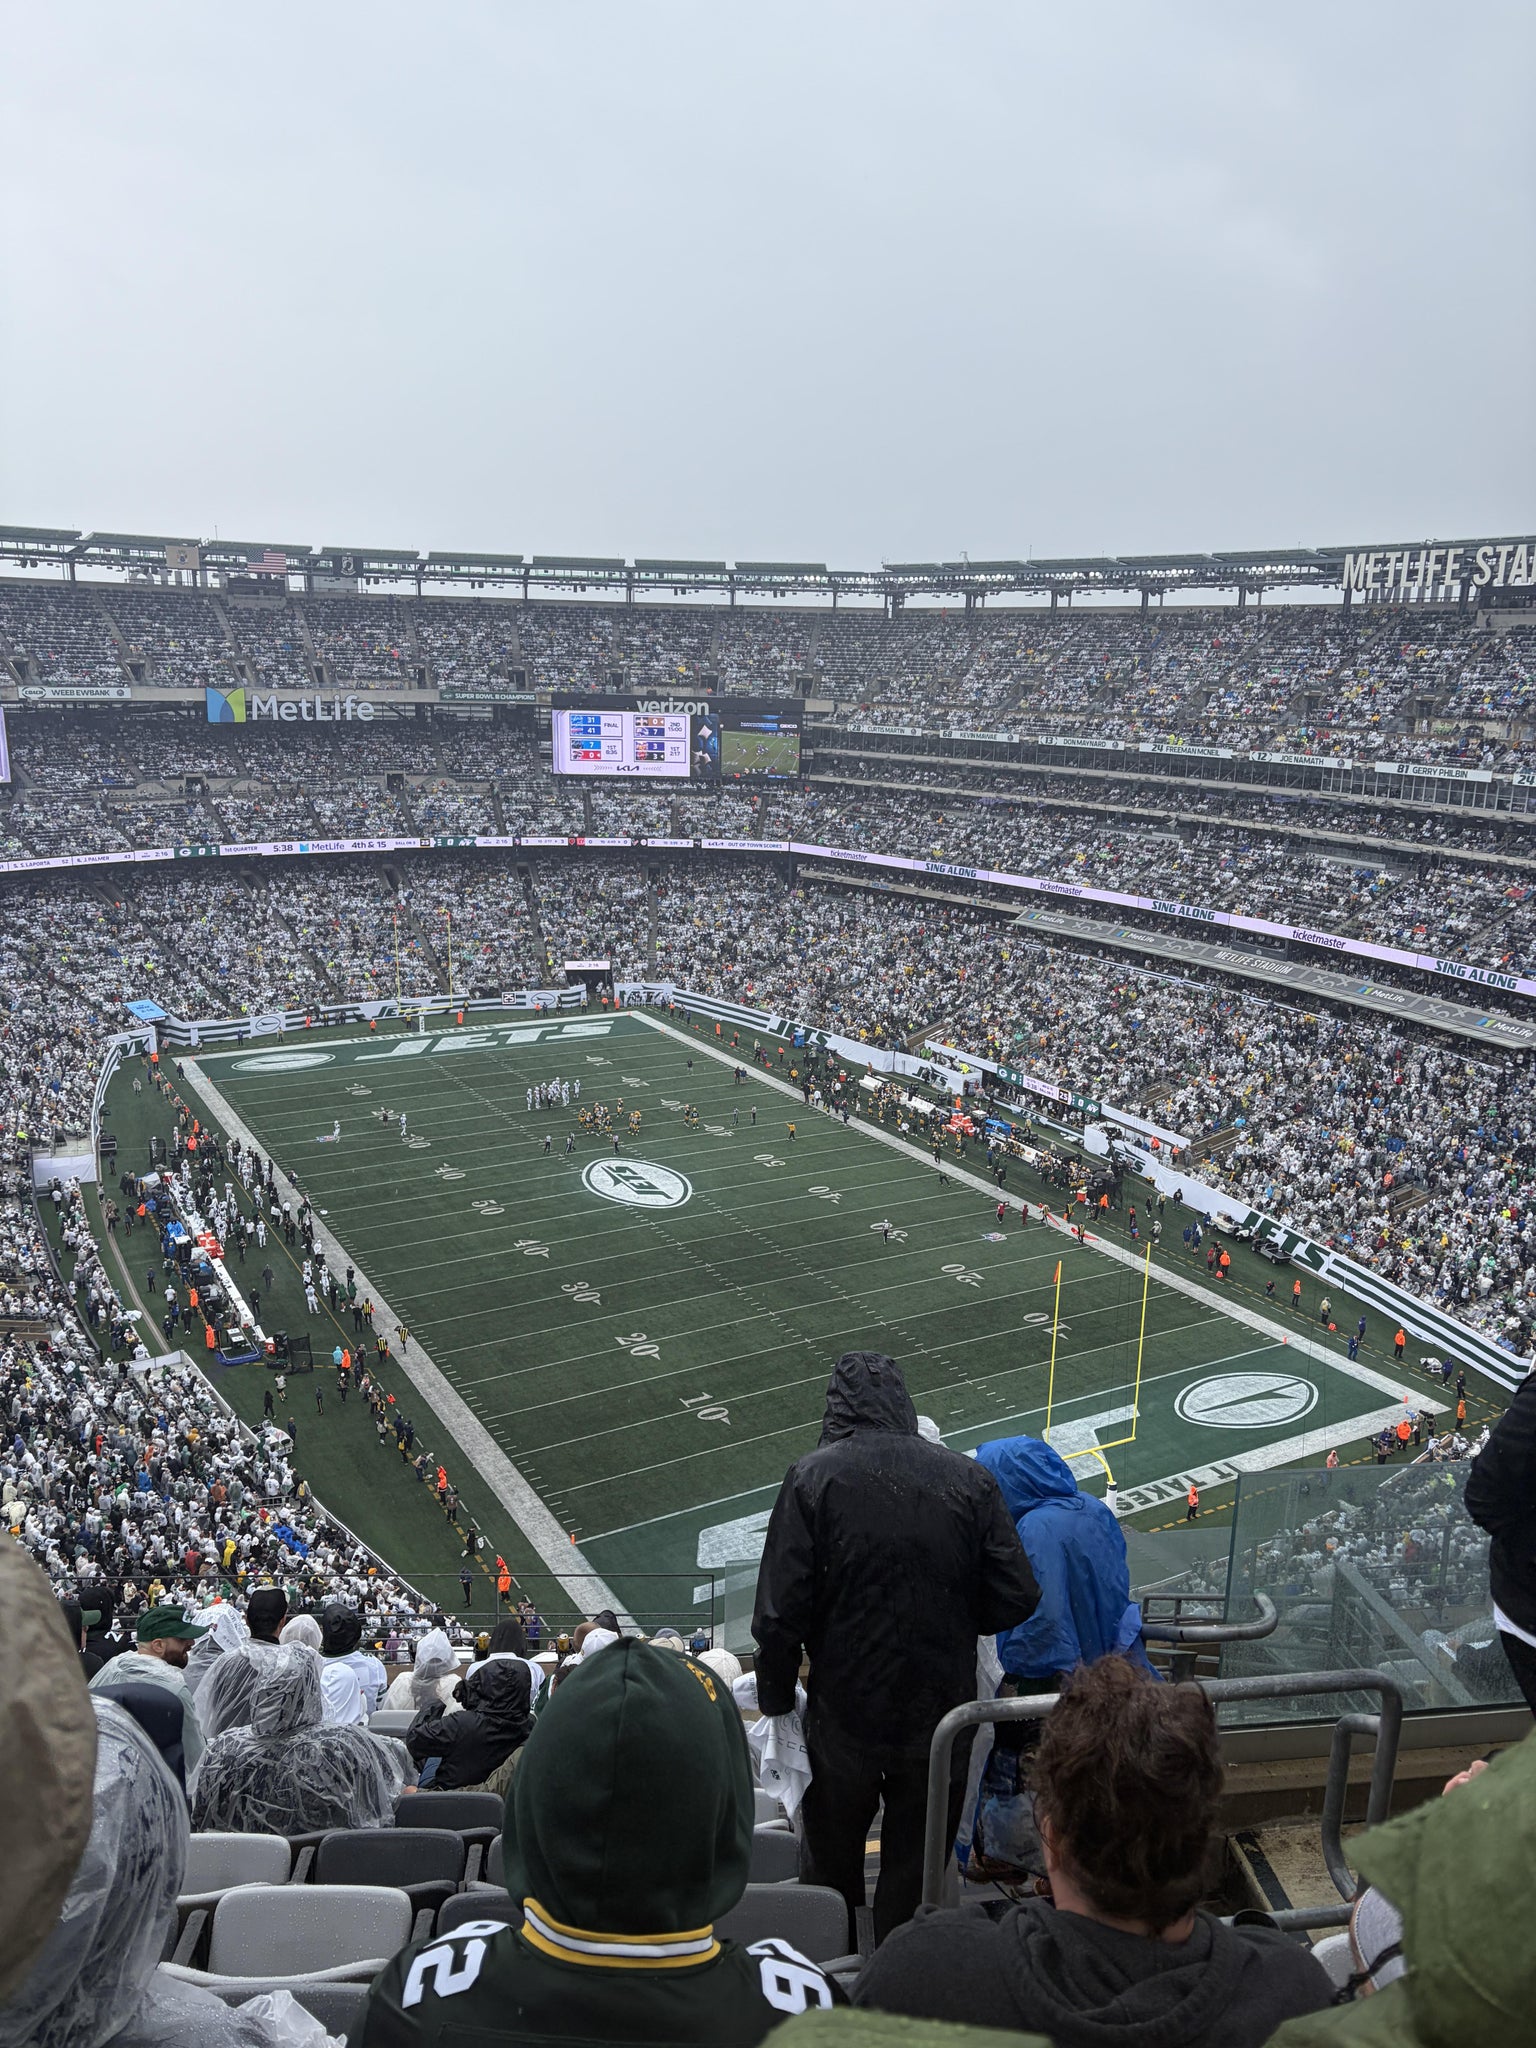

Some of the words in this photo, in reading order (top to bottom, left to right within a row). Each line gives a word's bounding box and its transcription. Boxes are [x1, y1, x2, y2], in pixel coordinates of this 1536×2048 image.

[1342, 547, 1464, 589] METLIFE
[1472, 543, 1536, 586] STA
[252, 694, 375, 721] MetLife
[637, 697, 709, 716] verizon
[1076, 739, 1106, 748] MAYNARD
[1151, 744, 1163, 752] 24
[1166, 746, 1196, 754] FREEMAN
[1196, 748, 1220, 756] MCNEIL
[1257, 752, 1267, 760] 12
[1293, 756, 1324, 765] NAMATH
[1397, 764, 1409, 773] 81
[1412, 767, 1438, 776] GERRY
[1438, 768, 1468, 778] PHILBIN
[1518, 775, 1535, 785] 24
[273, 844, 294, 852] 5:38
[311, 842, 345, 851] MetLife
[830, 850, 867, 861] ticketmaster
[925, 862, 946, 873] SING
[949, 866, 977, 878] ALONG
[1039, 881, 1083, 897] ticketmaster
[1151, 900, 1176, 914] SING
[1177, 905, 1215, 921] ALONG
[1039, 915, 1065, 925] MetLife
[1128, 932, 1155, 943] MetLife
[1292, 929, 1346, 950] ticketmaster
[1214, 951, 1253, 966] METLIFE
[1250, 959, 1294, 975] STADIUM
[1434, 959, 1466, 977] SING
[1468, 967, 1518, 990] ALONG
[1371, 989, 1406, 1003] MetLife
[371, 1005, 422, 1018] JETS
[1493, 1021, 1534, 1039] MetLife
[354, 1020, 614, 1061] JETS
[1060, 1091, 1068, 1099] 25
[435, 1167, 466, 1180] 40
[471, 1200, 505, 1216] 50
[513, 1239, 550, 1256] 40
[1235, 1211, 1331, 1272] JETS
[941, 1263, 985, 1284] 20
[561, 1281, 601, 1302] 30
[614, 1332, 660, 1356] 20
[679, 1392, 730, 1421] 10
[1209, 1461, 1242, 1480] IT
[1116, 1474, 1208, 1511] TAKES
